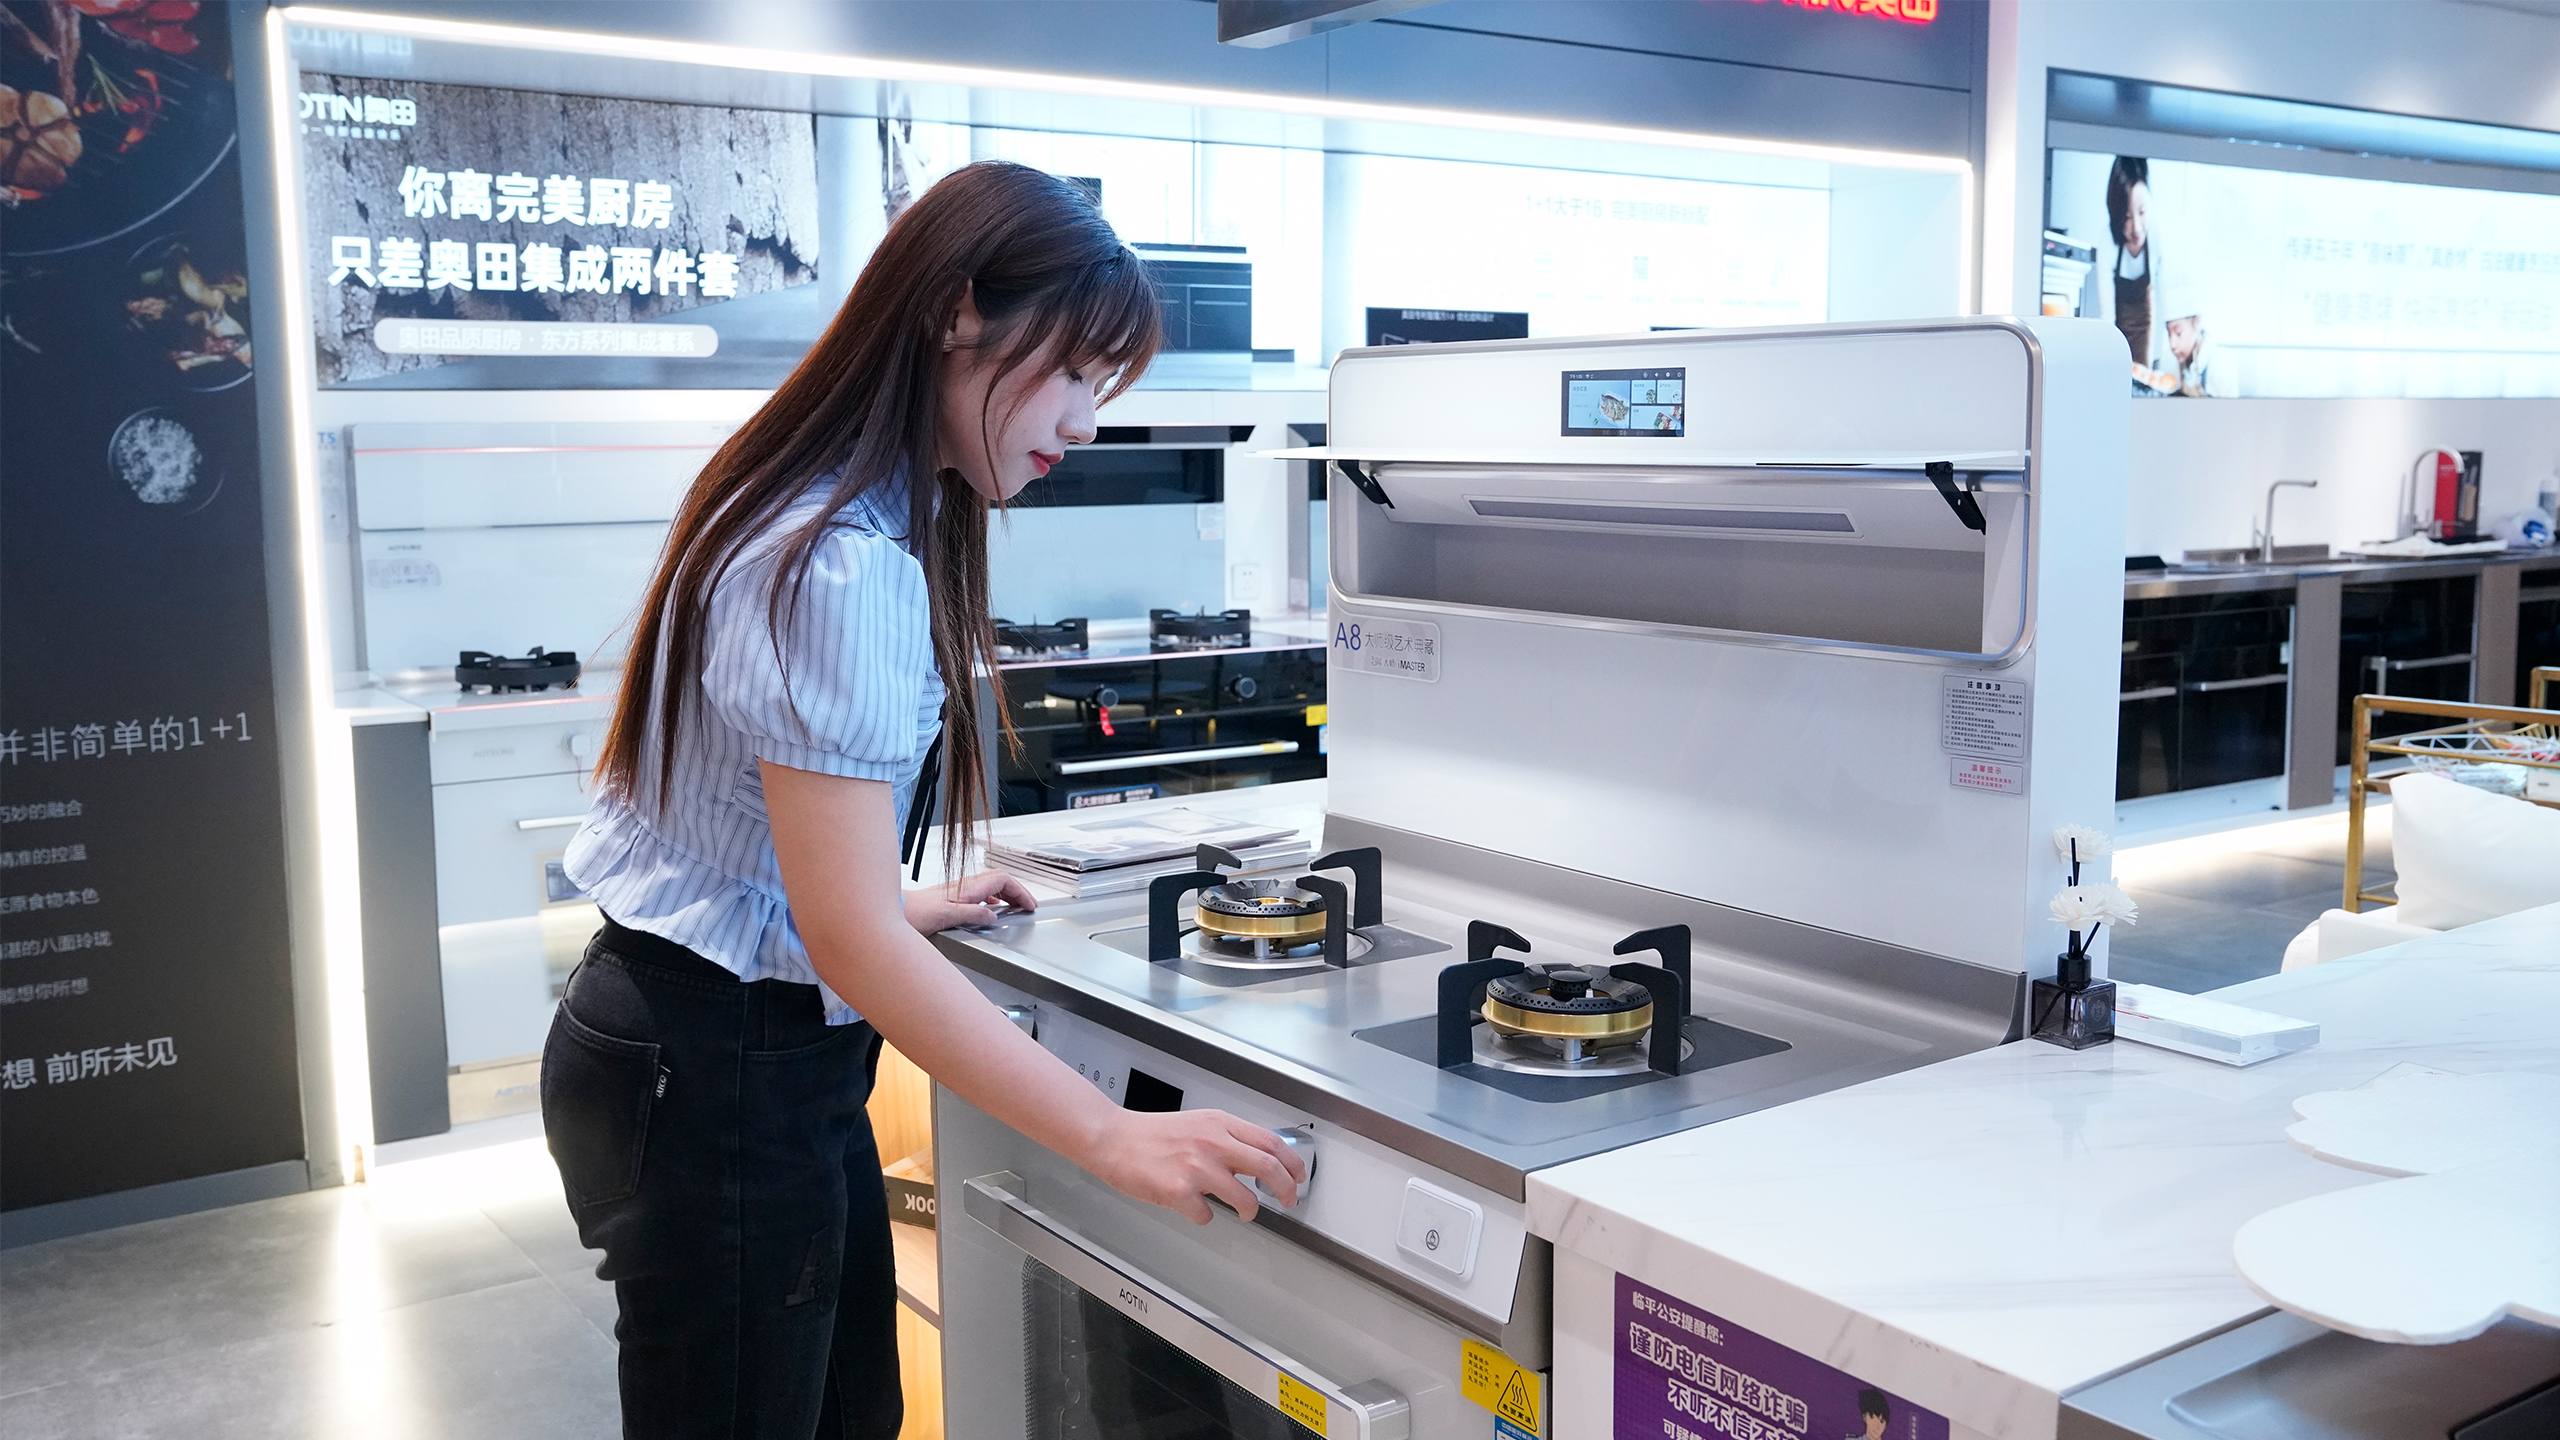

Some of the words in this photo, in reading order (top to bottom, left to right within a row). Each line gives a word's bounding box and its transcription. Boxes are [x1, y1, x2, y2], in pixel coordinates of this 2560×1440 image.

[397, 164, 675, 230] 你离完美厨房
[327, 235, 741, 299] 只差奥田集成两件套
[1334, 622, 1361, 651] A8
[1364, 631, 1435, 656] 大师级艺术典藏
[1397, 659, 1426, 673] iMASTER
[0, 712, 253, 766] 并非简单的1+1
[0, 929, 113, 961] 湛的八面玲珑
[0, 1057, 38, 1091] 想
[45, 1035, 179, 1085] 前所未见
[1119, 1287, 1148, 1314] AOTIN
[1630, 1321, 1808, 1434] 谨防电信网络诈骗
